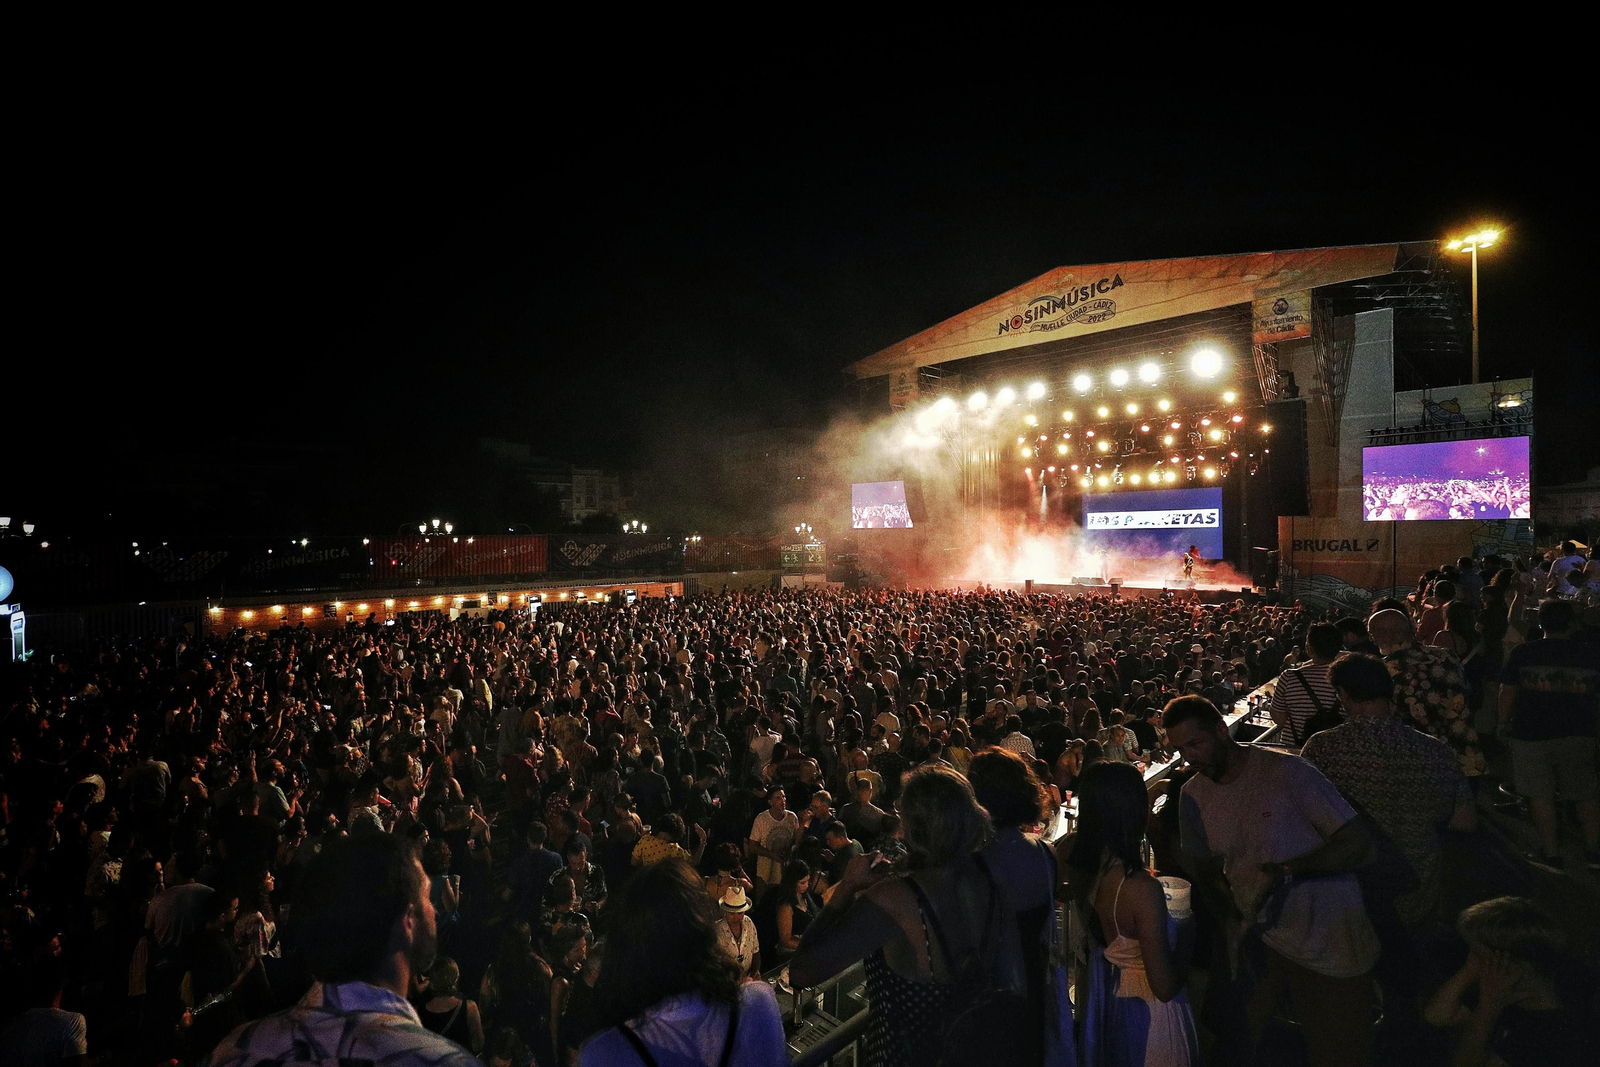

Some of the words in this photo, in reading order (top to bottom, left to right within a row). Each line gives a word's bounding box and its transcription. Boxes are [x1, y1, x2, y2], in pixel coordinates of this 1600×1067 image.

[999, 273, 1124, 335] NOSINMÚSICA
[1040, 319, 1065, 331] MUELLE
[1066, 306, 1088, 322] CIUDAD
[1088, 312, 1107, 323] 2022
[1292, 539, 1363, 552] BRUGAL
